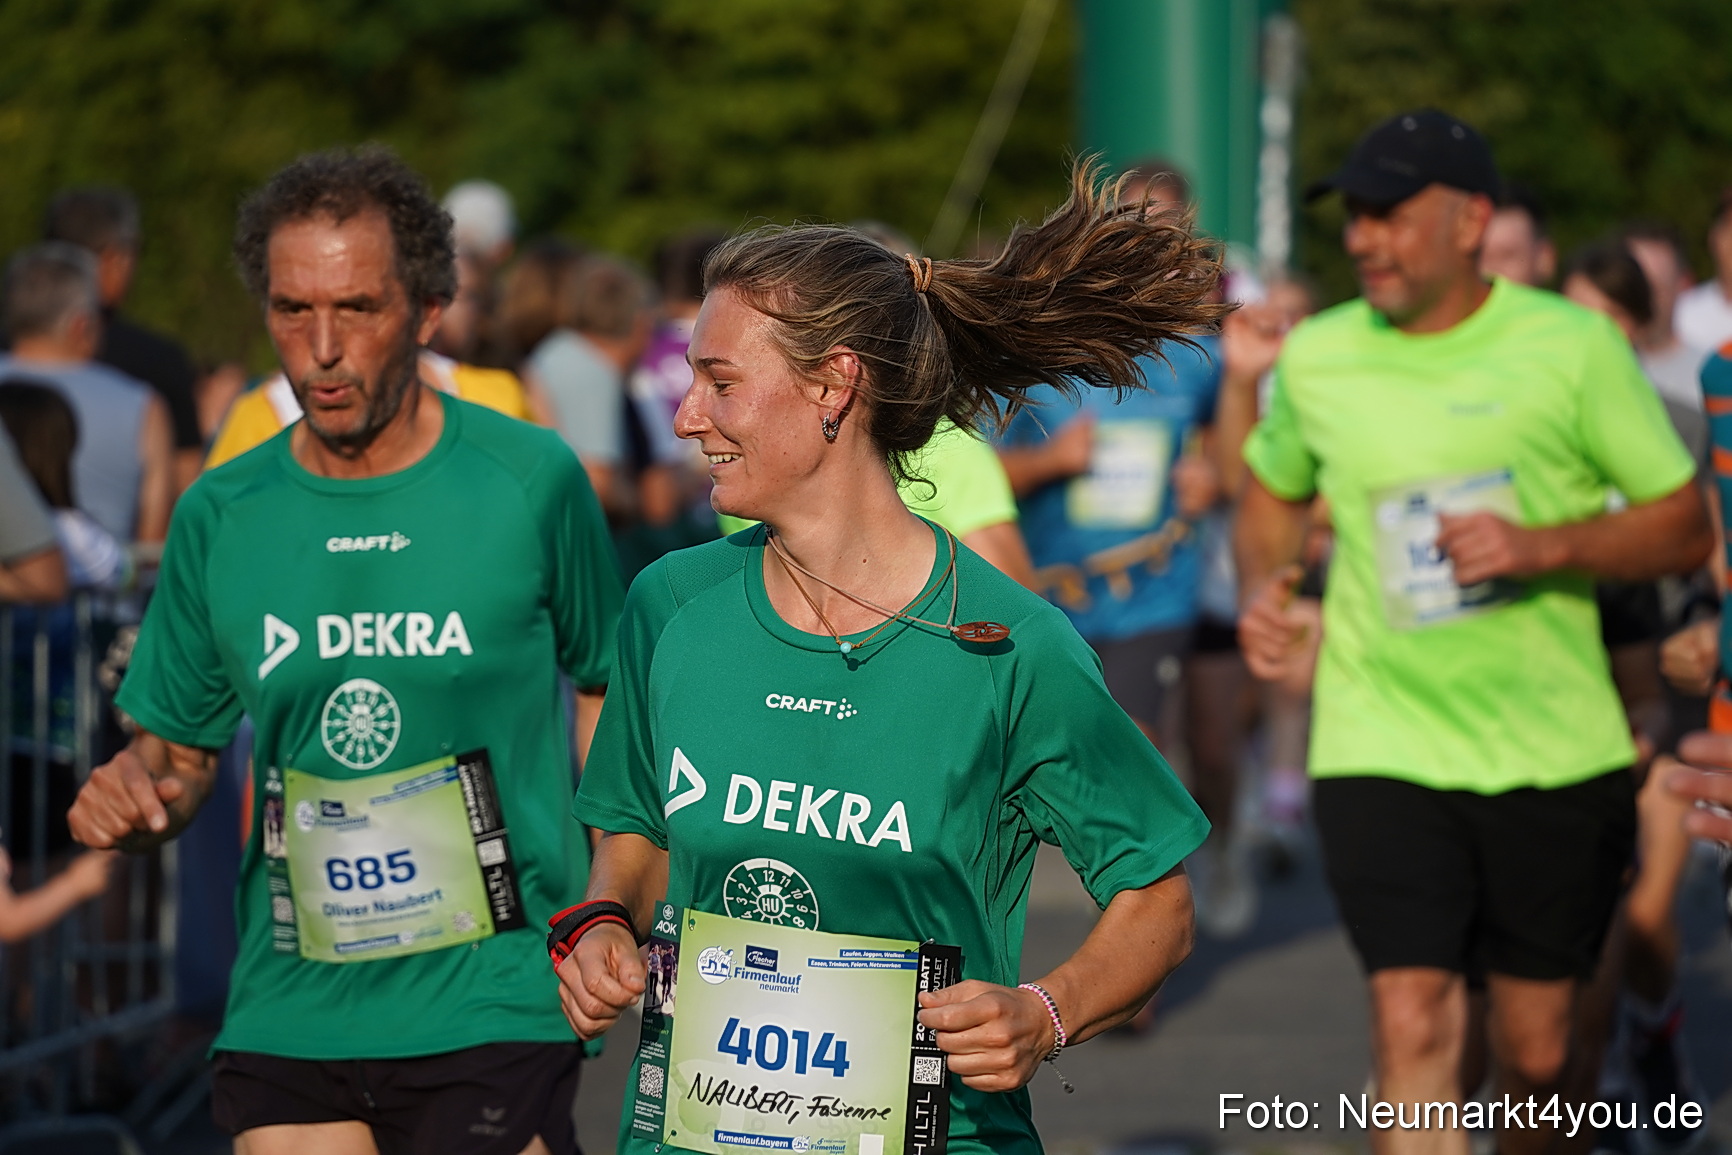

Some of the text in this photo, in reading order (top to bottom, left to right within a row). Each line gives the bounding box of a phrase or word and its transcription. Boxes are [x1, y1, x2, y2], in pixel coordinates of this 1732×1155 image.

[326, 535, 391, 552] CRAFT
[317, 611, 474, 660] DEKRA
[765, 693, 837, 715] CRAFT
[723, 774, 913, 853] DEKRA
[326, 849, 416, 891] 685
[762, 869, 775, 883] 12
[738, 883, 751, 894] 2
[780, 875, 791, 888] 11
[762, 897, 779, 913] HU
[655, 920, 677, 936] AOK
[792, 916, 805, 928] 8
[734, 966, 802, 985] Firmenlauf
[919, 955, 931, 993] BATT
[759, 983, 799, 994] neumarkt
[717, 1016, 850, 1078] 4014
[687, 1072, 892, 1125] NAUBERT, Fabienne
[913, 1091, 931, 1155] HILTL
[717, 1132, 789, 1149] firmenlauf.bayern
